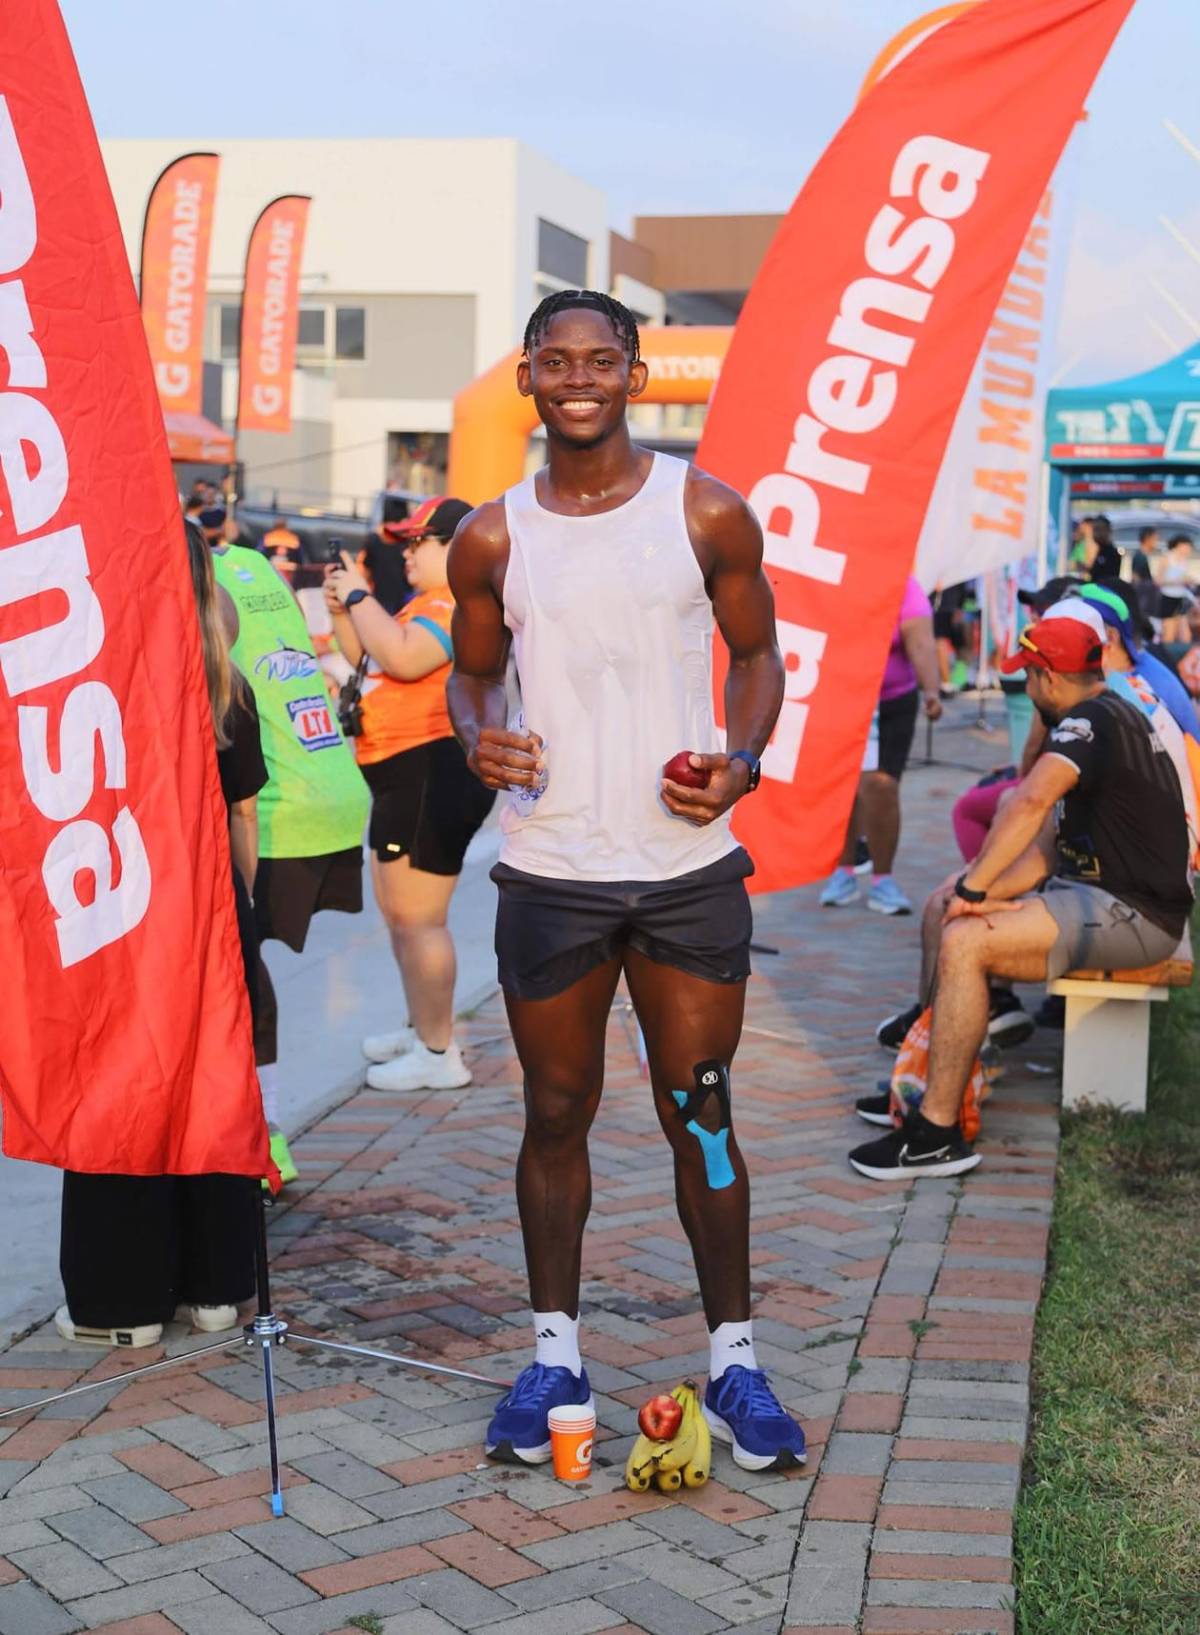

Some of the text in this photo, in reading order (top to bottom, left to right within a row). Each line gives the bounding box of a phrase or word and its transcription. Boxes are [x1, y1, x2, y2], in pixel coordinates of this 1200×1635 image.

[157, 179, 202, 398] G GATORADE
[252, 218, 296, 417] G GATORADE
[747, 135, 992, 586] Prensa
[971, 187, 1053, 541] LA MUNDIA
[0, 92, 152, 970] ensa
